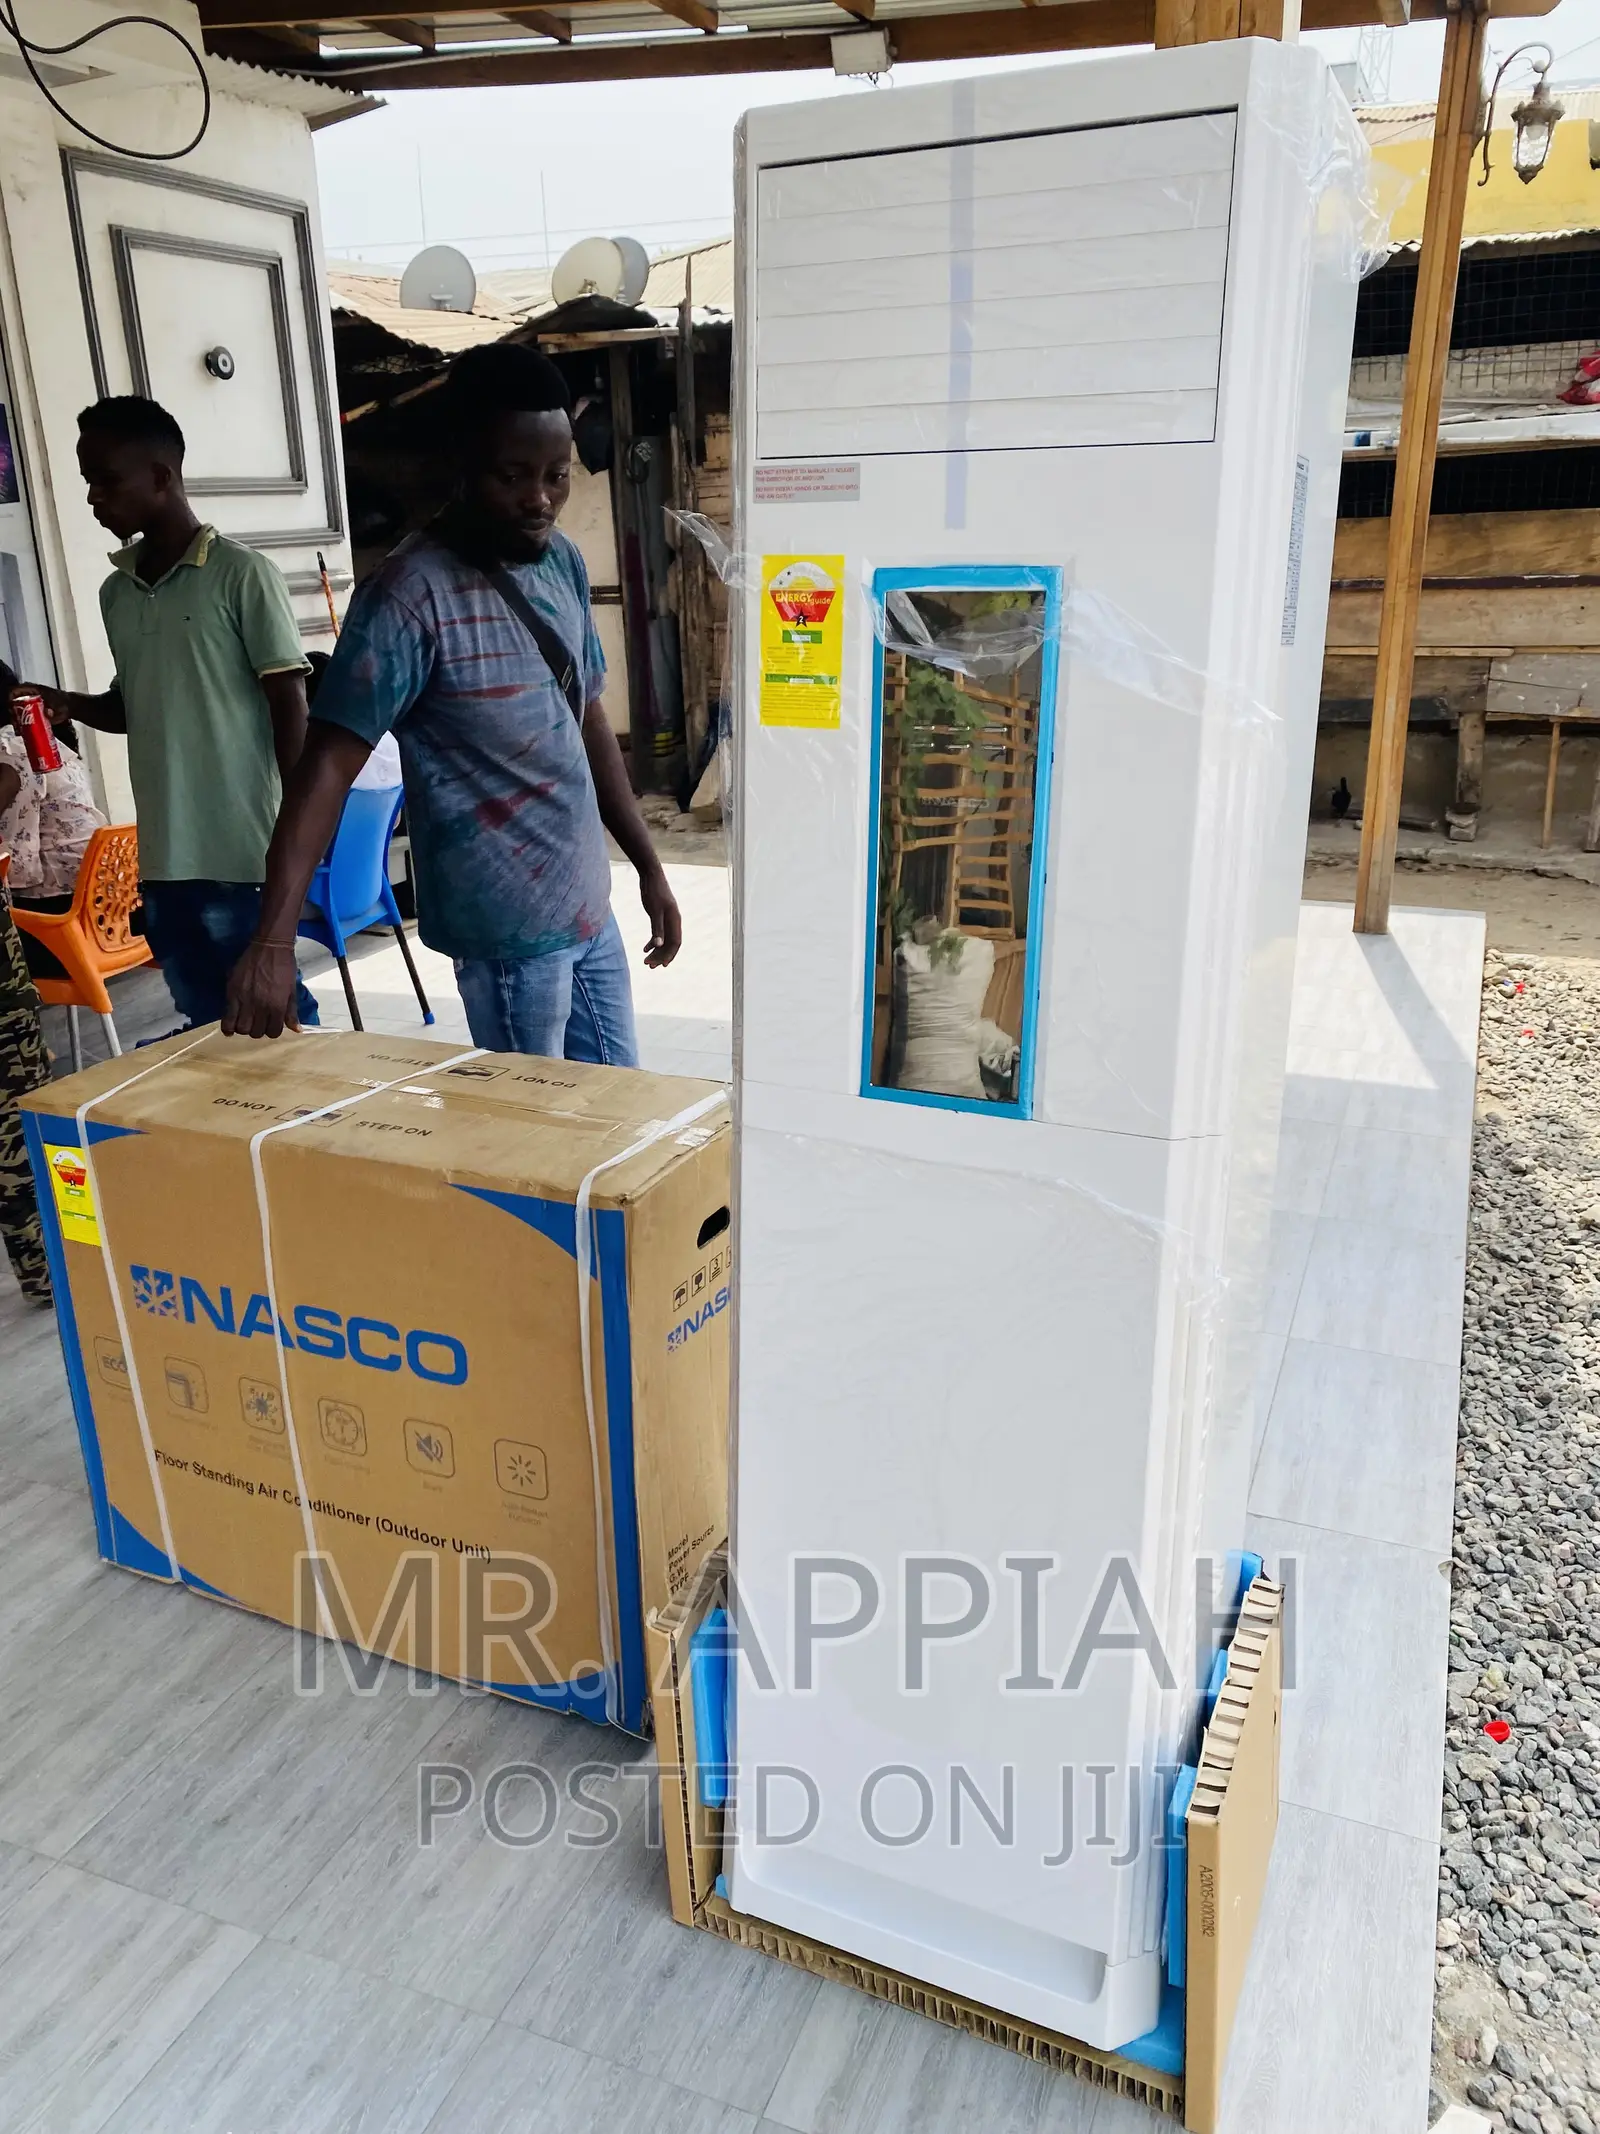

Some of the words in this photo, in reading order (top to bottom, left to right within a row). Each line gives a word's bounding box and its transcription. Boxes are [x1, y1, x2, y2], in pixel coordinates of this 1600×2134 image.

[775, 592, 812, 603] ENERGY
[811, 598, 831, 606] guide
[391, 1057, 434, 1067] STEP
[511, 1075, 549, 1085] NOT
[212, 1098, 239, 1106] DO
[238, 1102, 277, 1111] NOT
[356, 1120, 403, 1131] STEP
[404, 1128, 432, 1136] ON
[179, 1276, 469, 1386] NASCO
[154, 1449, 189, 1472] Floor
[192, 1461, 254, 1496] Standing
[258, 1482, 278, 1500] Air
[375, 1515, 447, 1550] (Outdoor
[451, 1537, 491, 1564] Unit)
[668, 1534, 689, 1561] Model
[668, 1547, 690, 1573] Power
[691, 1524, 715, 1551] Source
